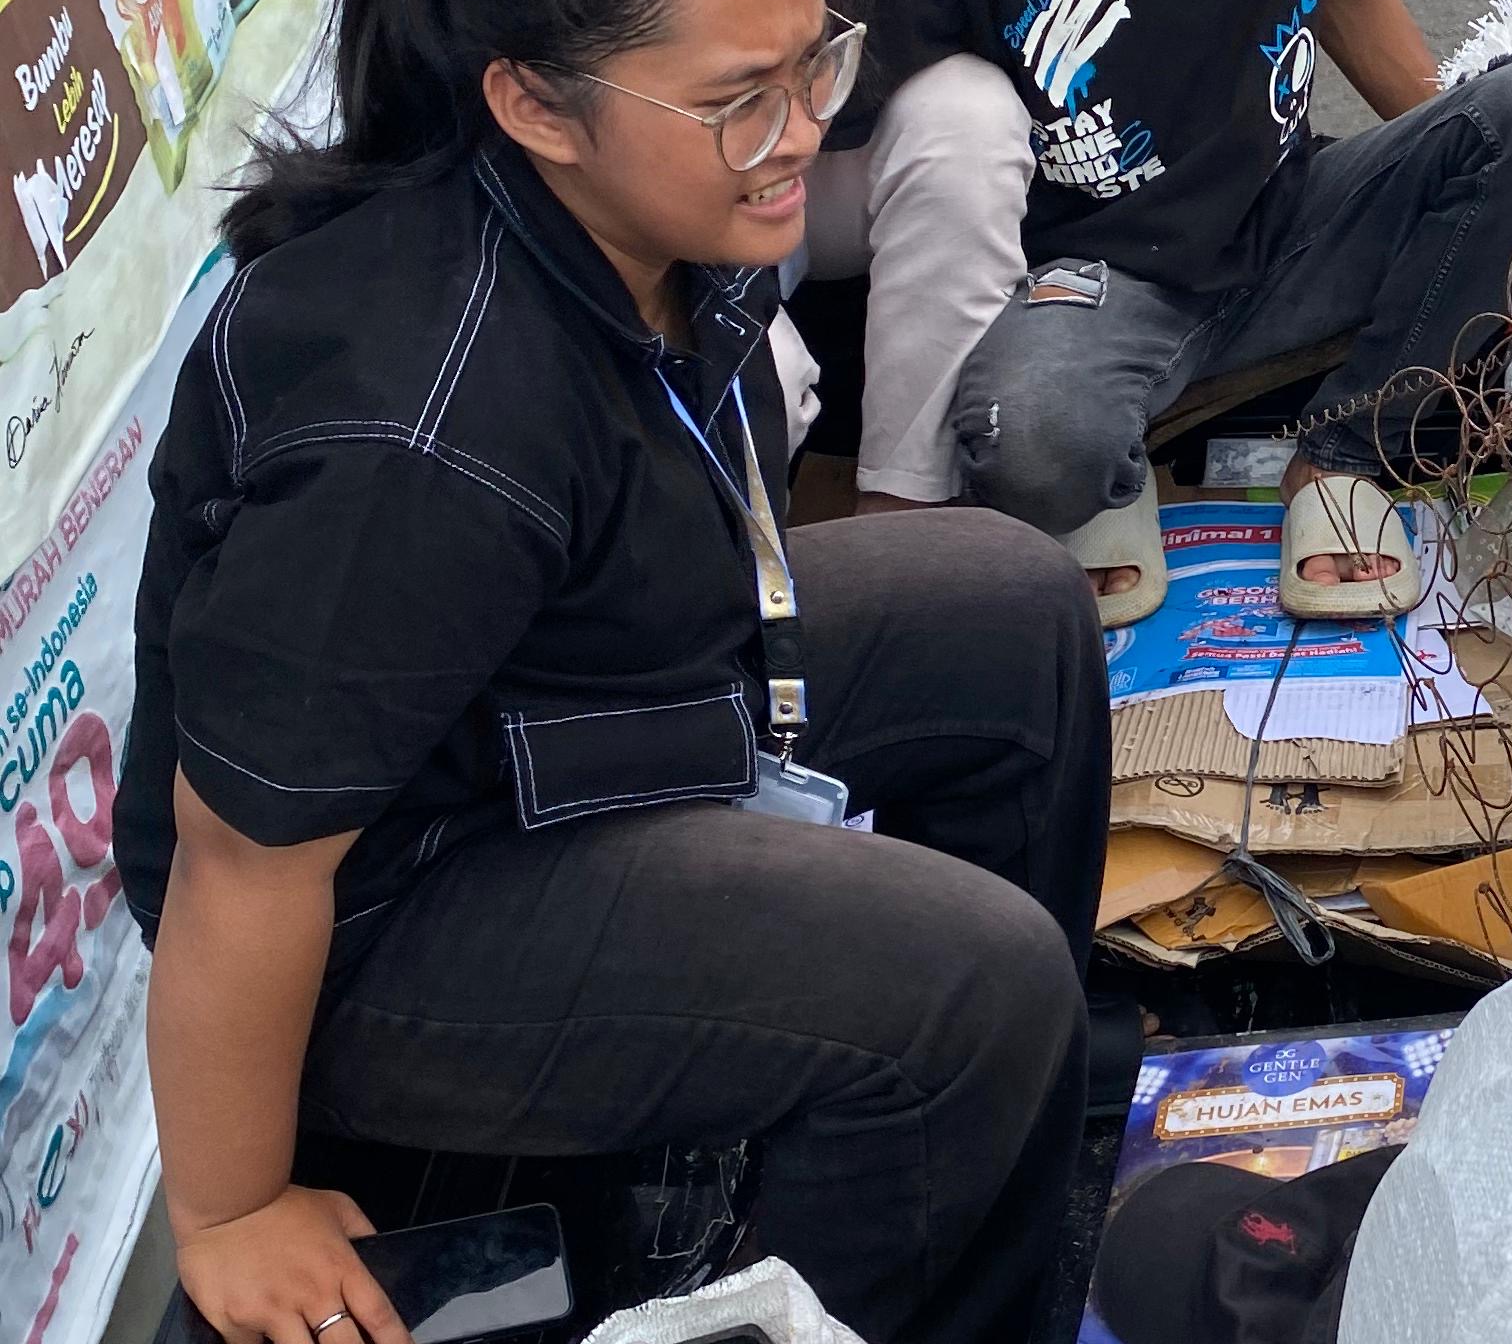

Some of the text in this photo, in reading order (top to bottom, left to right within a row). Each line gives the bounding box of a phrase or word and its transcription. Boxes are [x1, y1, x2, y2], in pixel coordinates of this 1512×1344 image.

[15, 6, 74, 111] Bumbu
[58, 415, 143, 553] BENERAN
[1162, 528, 1252, 547] inimal
[0, 657, 87, 814] cuma
[1249, 1058, 1320, 1073] GENTLE
[1264, 1070, 1301, 1084] GEN
[1197, 1091, 1364, 1123] HUJAN EMAS
